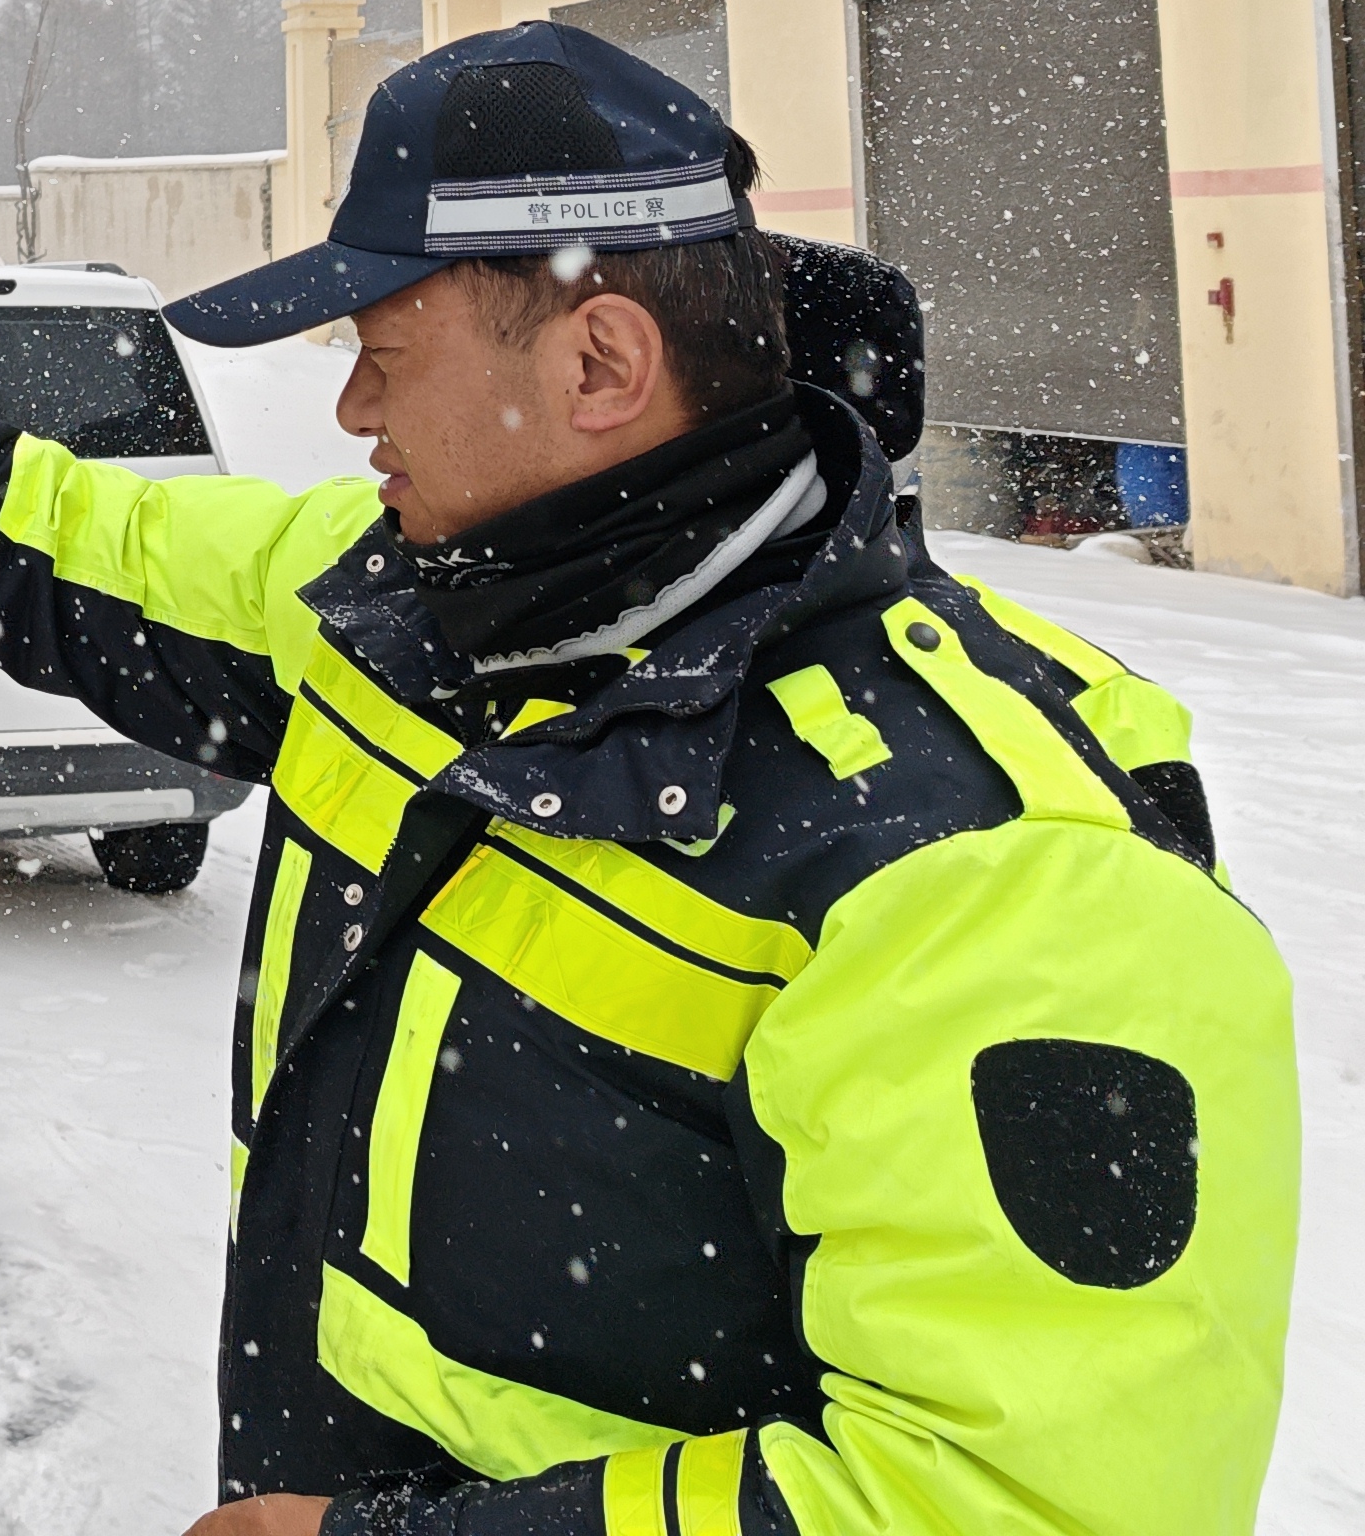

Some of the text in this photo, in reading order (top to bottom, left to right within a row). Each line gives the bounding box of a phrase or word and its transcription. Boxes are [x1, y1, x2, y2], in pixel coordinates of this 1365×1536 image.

[528, 197, 665, 224] 警 POLICE 察
